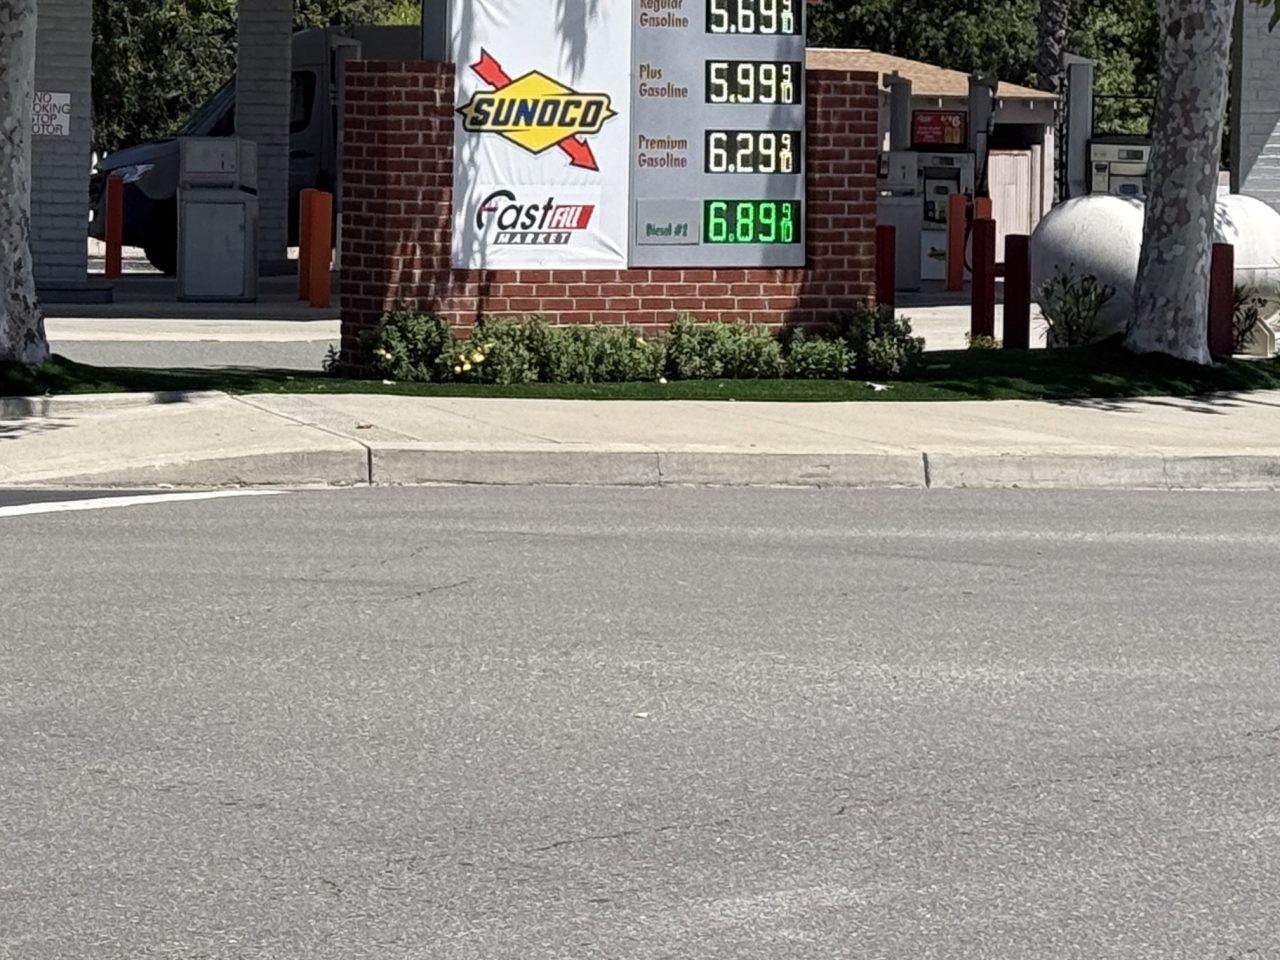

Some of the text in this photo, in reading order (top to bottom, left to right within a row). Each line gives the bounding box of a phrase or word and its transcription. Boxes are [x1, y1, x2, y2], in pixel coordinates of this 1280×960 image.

[639, 12, 689, 27] Gasoline
[639, 64, 662, 80] Plus
[33, 92, 52, 103] NO
[638, 82, 689, 98] Gasoline
[33, 103, 72, 114] OKING
[469, 97, 604, 128] SUNOCO
[31, 124, 64, 136] OTOR
[638, 134, 688, 150] Premium
[638, 153, 688, 168] Gasoline
[476, 189, 554, 231] Fast
[496, 232, 571, 244] MARKET
[645, 223, 672, 238] Diesel
